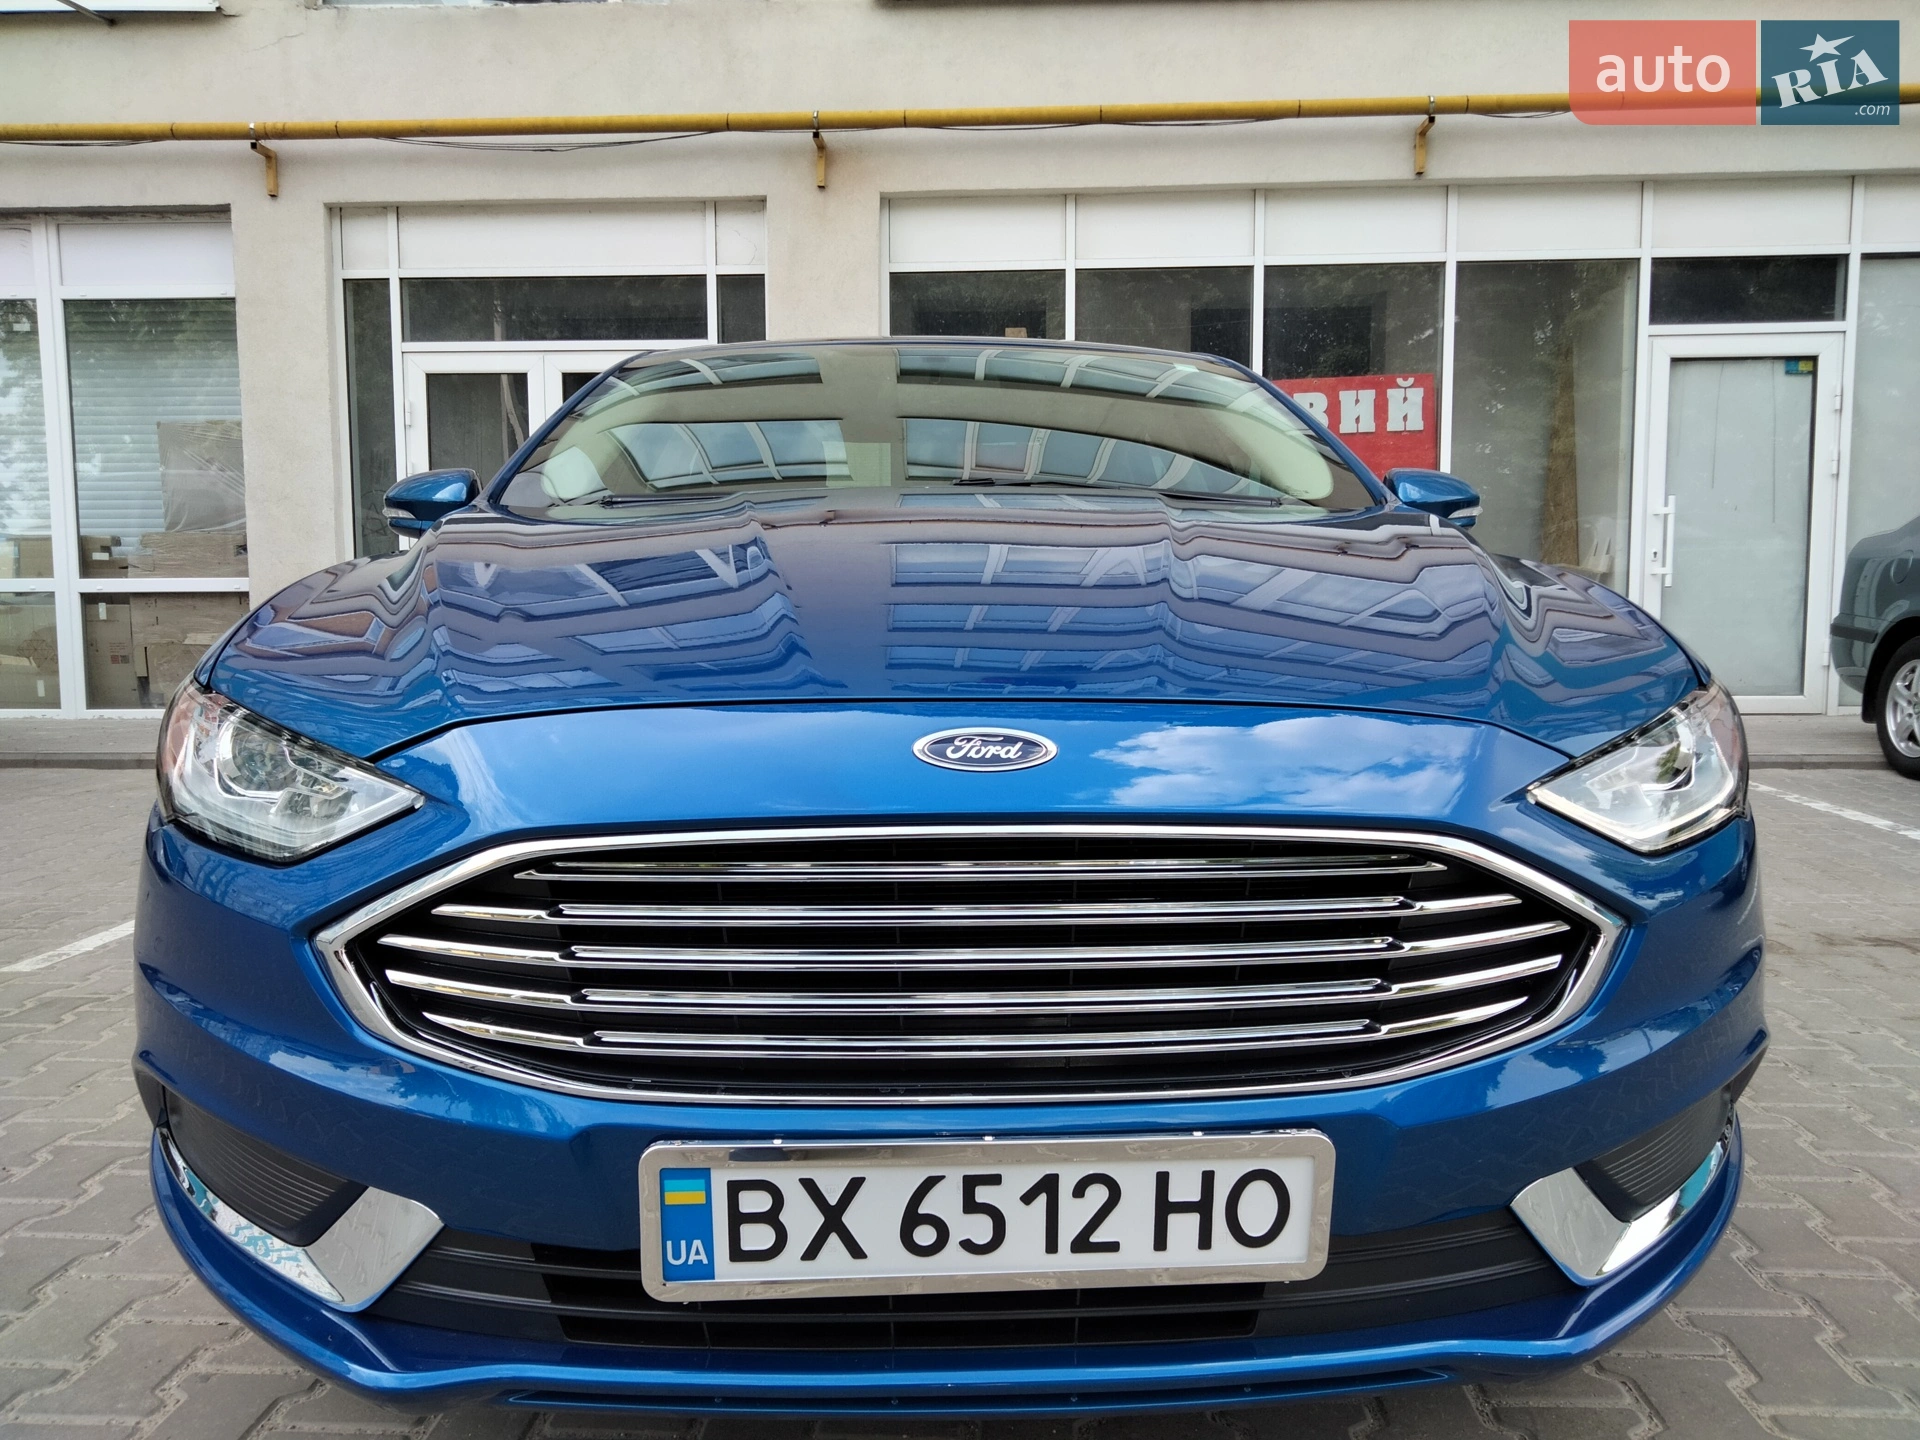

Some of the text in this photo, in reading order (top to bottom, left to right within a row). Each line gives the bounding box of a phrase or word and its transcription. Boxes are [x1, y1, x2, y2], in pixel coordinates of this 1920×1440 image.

[946, 735, 1024, 759] Ford
[727, 1168, 1291, 1263] BX 6512 HO
[666, 1239, 709, 1266] UA
